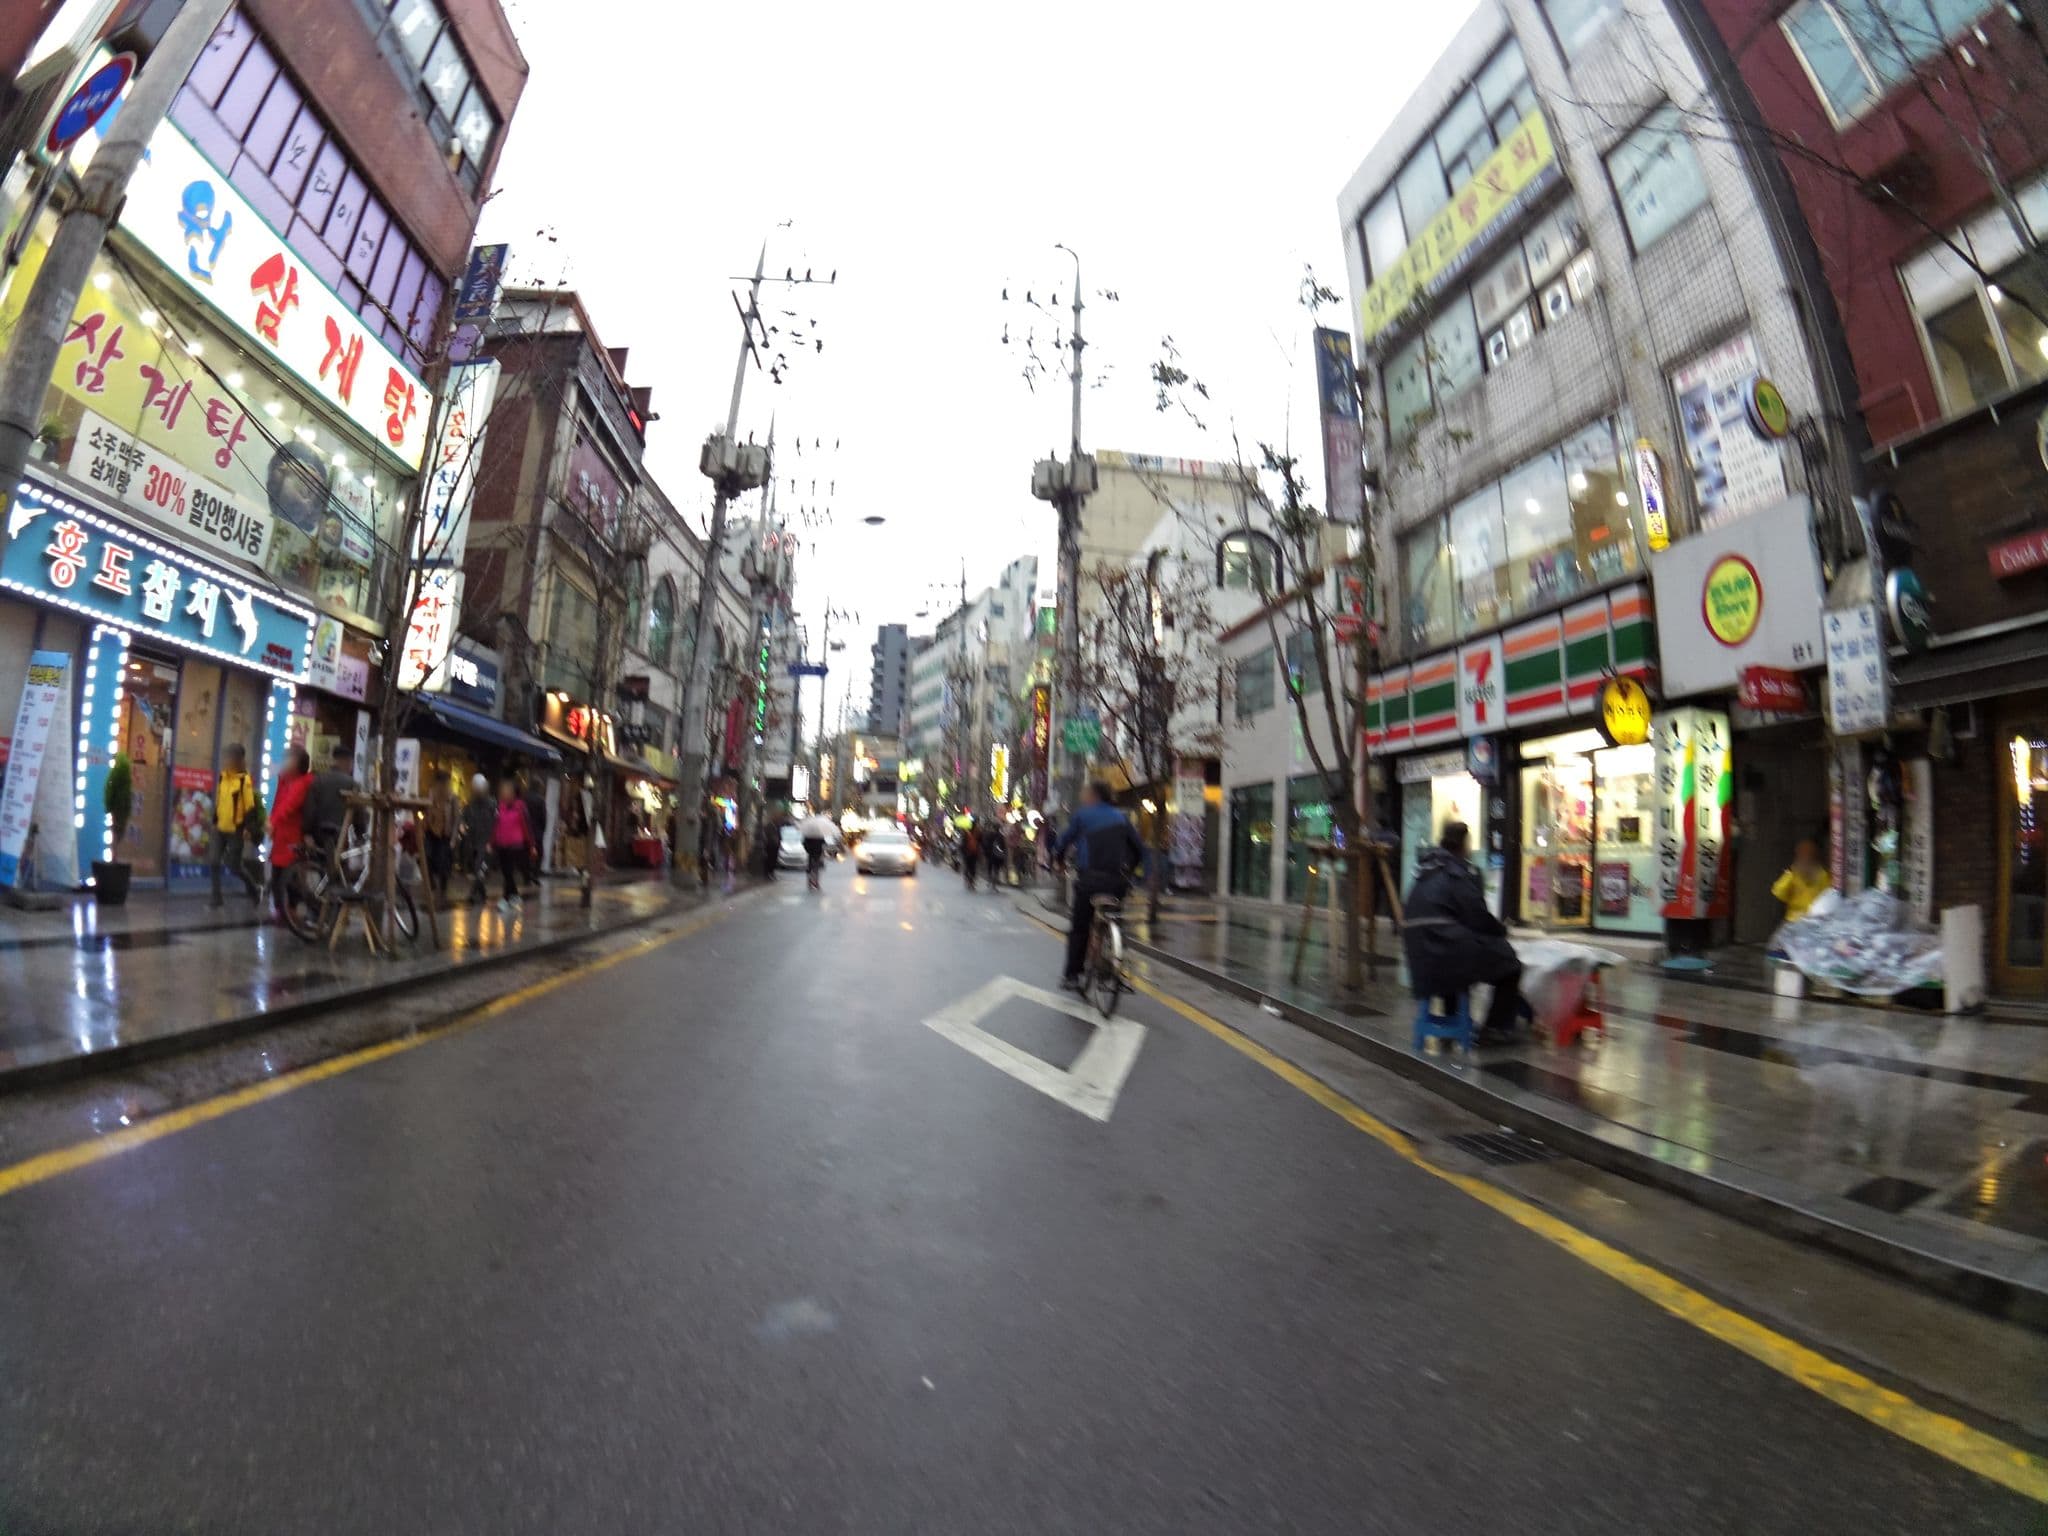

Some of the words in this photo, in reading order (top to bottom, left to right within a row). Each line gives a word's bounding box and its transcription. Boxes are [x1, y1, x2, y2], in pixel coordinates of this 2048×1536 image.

[63, 312, 248, 469] 삼계탕
[90, 456, 132, 494] 삼계탕
[143, 464, 187, 516] 30%
[187, 488, 265, 557] 할인행사중
[46, 519, 221, 638] 홍도참치
